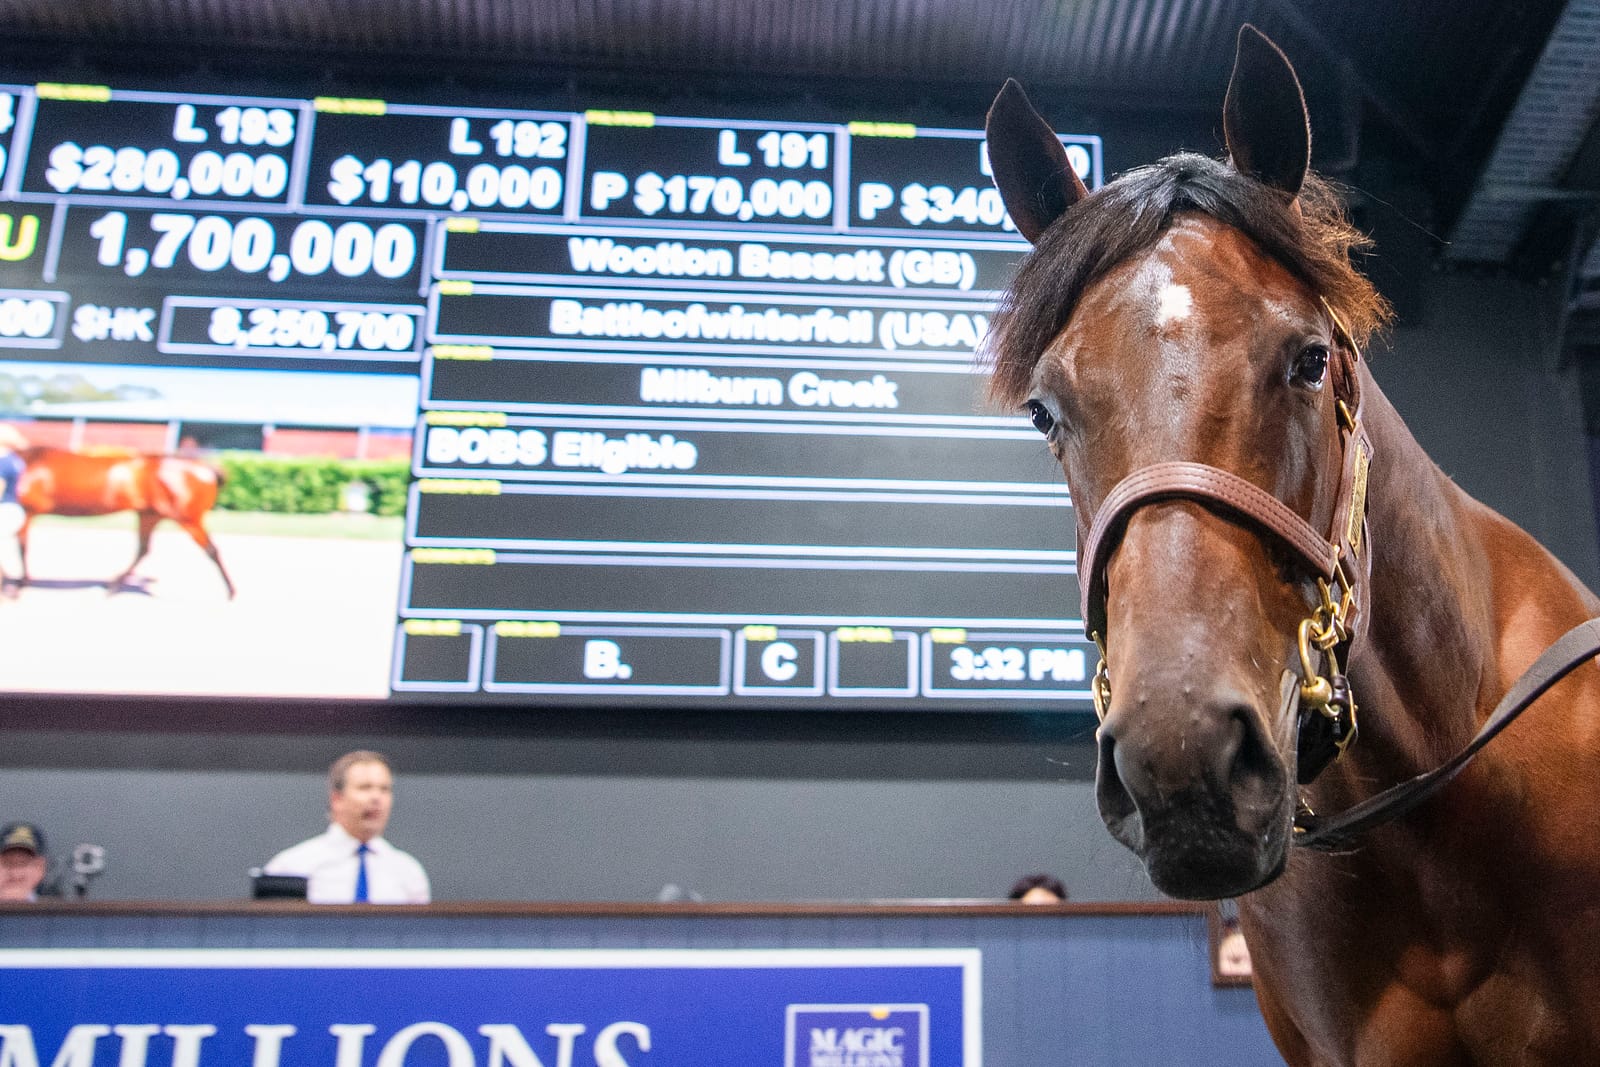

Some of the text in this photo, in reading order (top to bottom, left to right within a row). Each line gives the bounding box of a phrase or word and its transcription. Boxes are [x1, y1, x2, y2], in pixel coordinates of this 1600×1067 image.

[173, 104, 294, 146] L 193
[450, 118, 567, 158] L 192
[719, 129, 829, 169] L 191
[45, 141, 289, 201] $280,000
[327, 155, 562, 212] $110,000
[591, 172, 832, 221] P $170,000
[859, 183, 894, 220] P
[90, 211, 416, 282] 1,700,000
[567, 237, 977, 291] Wootton Bassett (GB)
[72, 303, 155, 342] $HK
[208, 306, 413, 352] 8,250,700
[787, 371, 899, 409] Creek
[426, 427, 698, 474] BOBS Eligible
[583, 640, 632, 679] B.
[761, 642, 798, 681] C
[950, 647, 1086, 682] 3:32 PM
[811, 1027, 905, 1052] MAGIC
